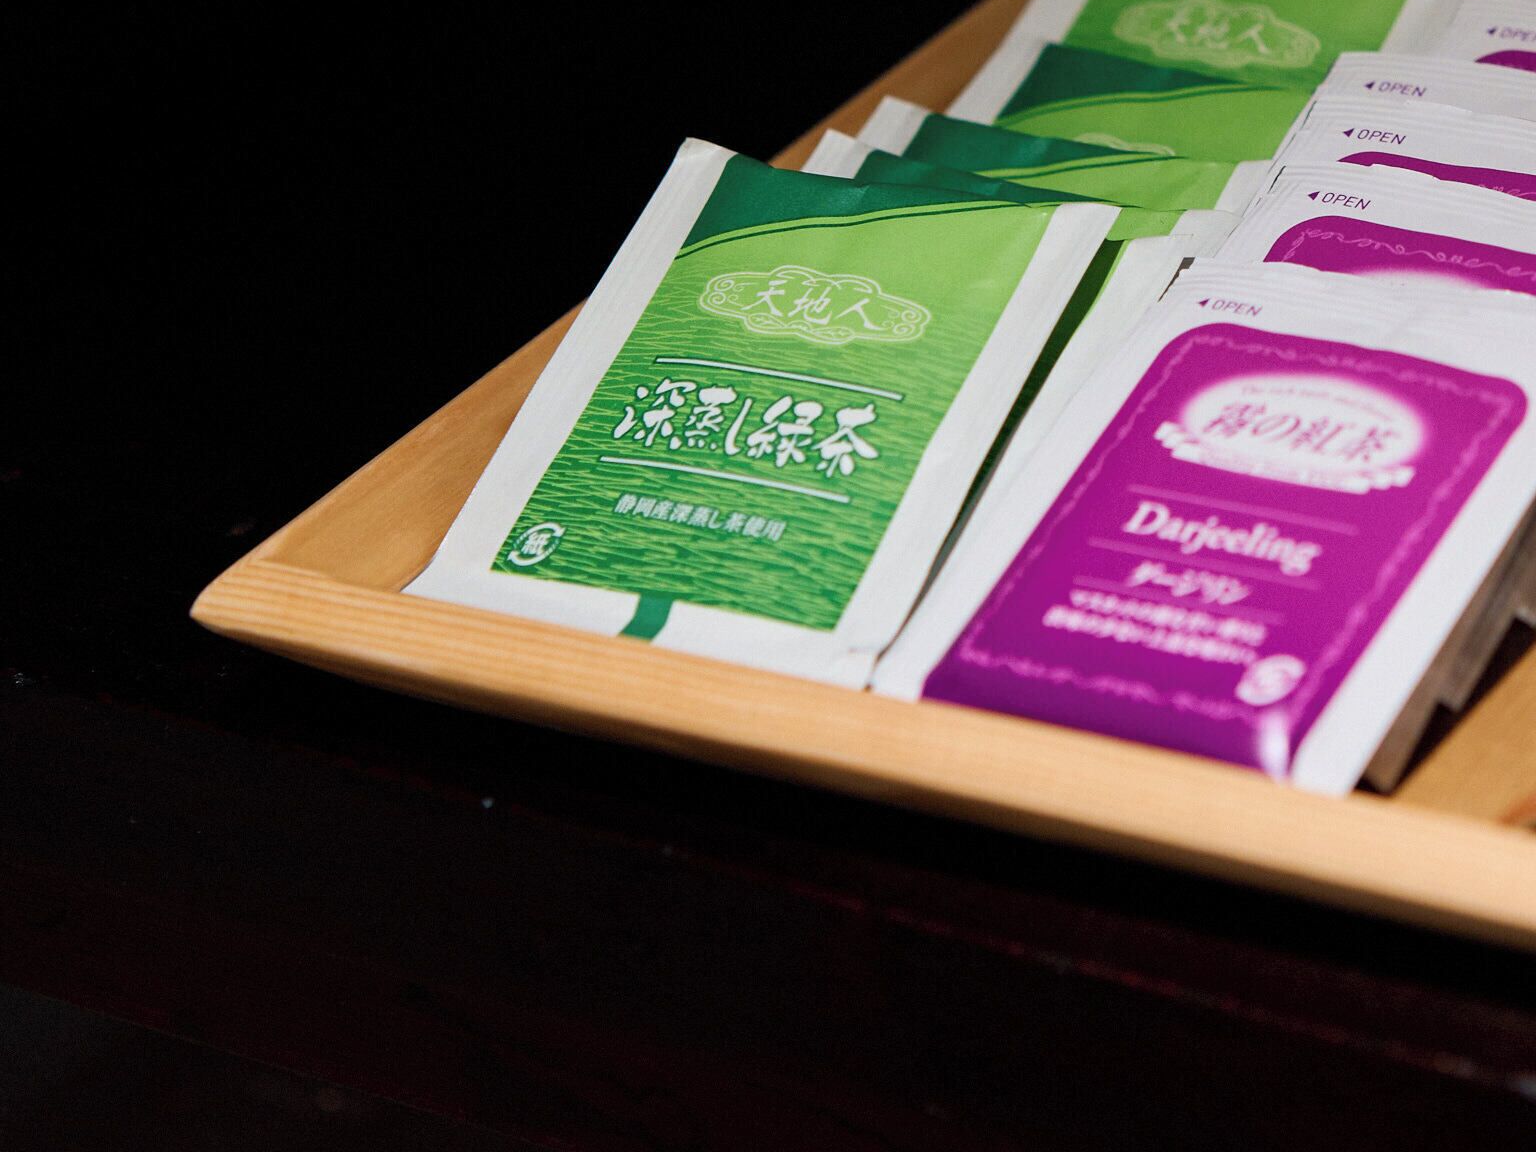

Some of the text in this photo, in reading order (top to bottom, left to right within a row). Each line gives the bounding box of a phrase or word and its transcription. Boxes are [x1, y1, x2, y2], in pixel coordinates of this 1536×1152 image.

[1377, 80, 1428, 98] OPEN
[1356, 127, 1407, 145] OPEN
[1321, 191, 1372, 211] OPEN
[740, 279, 888, 331] 天地人
[1211, 299, 1264, 318] OPEN
[612, 377, 880, 478] 深蒸し緑茶
[1121, 499, 1323, 577] Darjeeling
